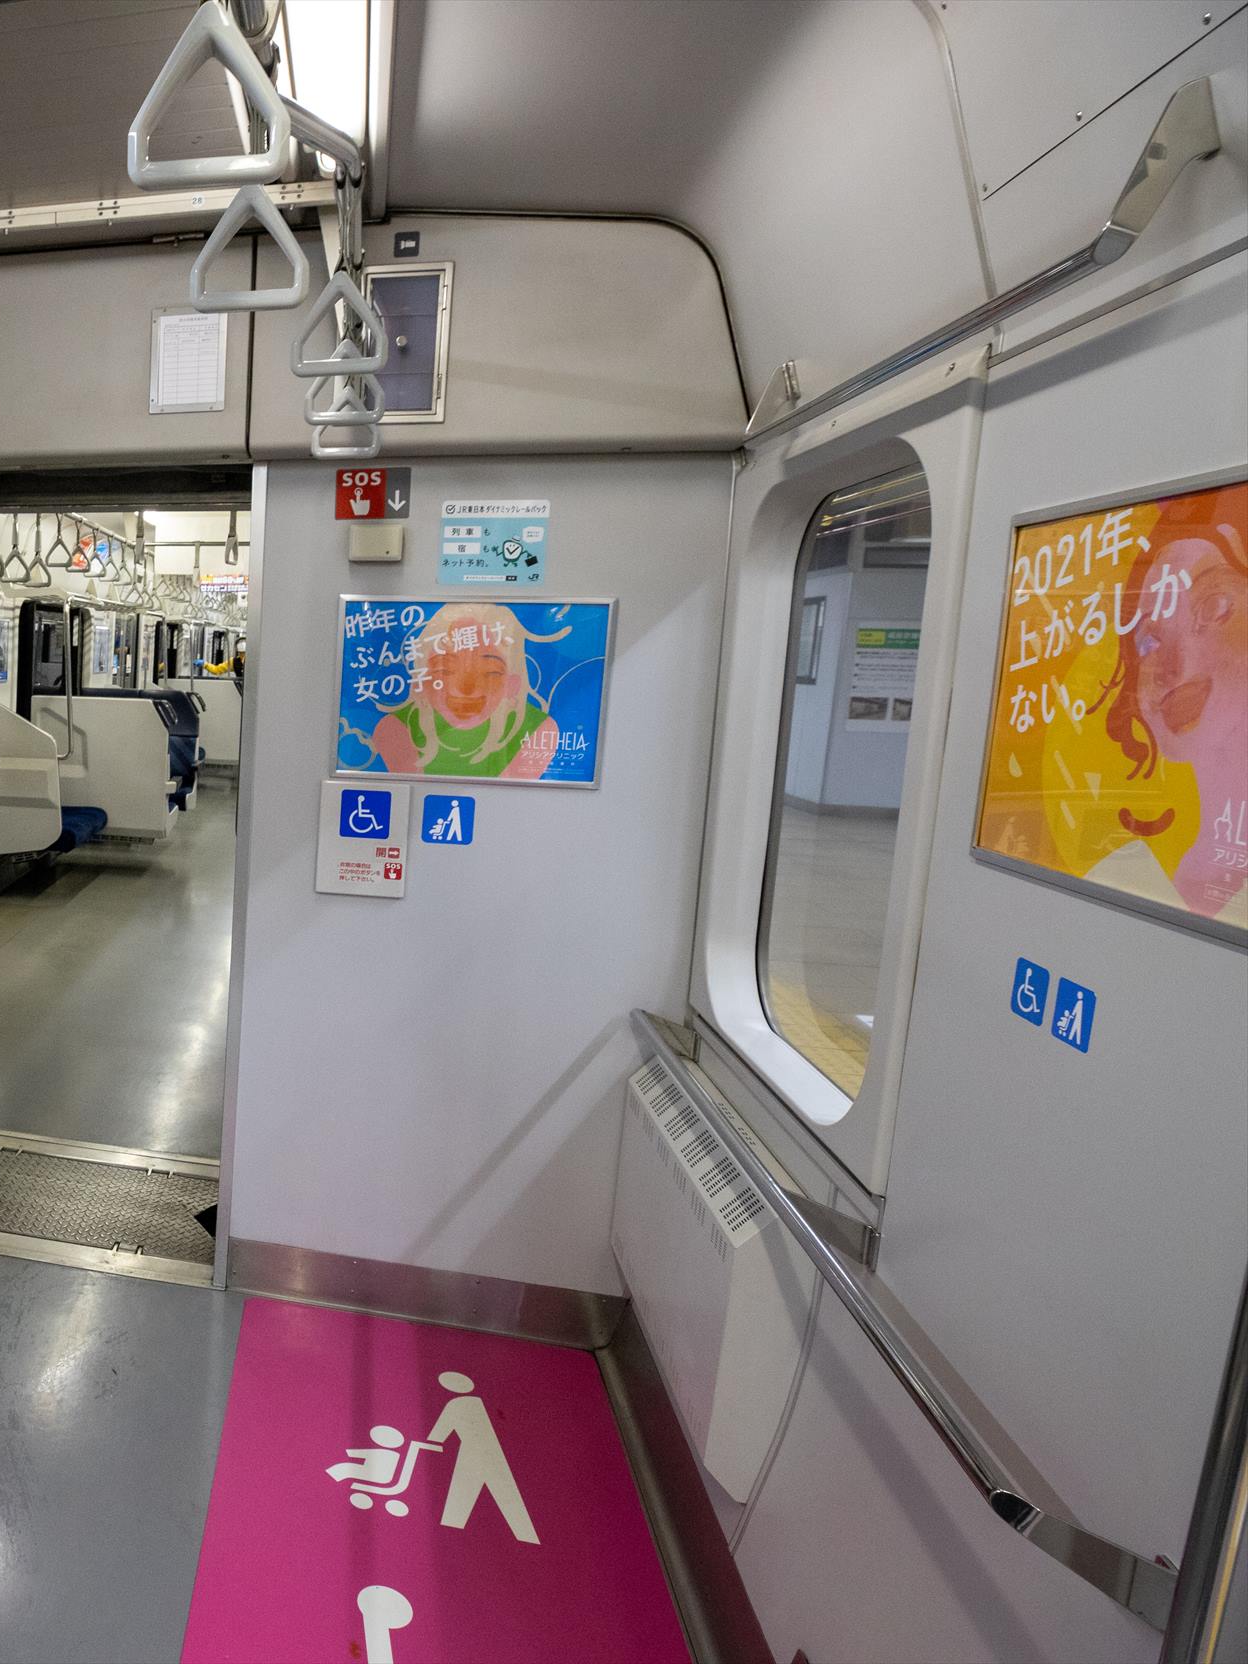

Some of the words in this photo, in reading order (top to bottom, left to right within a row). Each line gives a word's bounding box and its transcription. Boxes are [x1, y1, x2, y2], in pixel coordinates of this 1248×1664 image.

[342, 471, 382, 487] SOS
[1013, 507, 1151, 607] 2021年、
[346, 605, 425, 639] 昨年の
[1009, 562, 1193, 673] 上がるしか
[350, 621, 515, 669] ぶんまで輝け、
[353, 667, 444, 702] 女の子。
[1009, 683, 1086, 734] ない。
[520, 731, 591, 751] ALETHEIA
